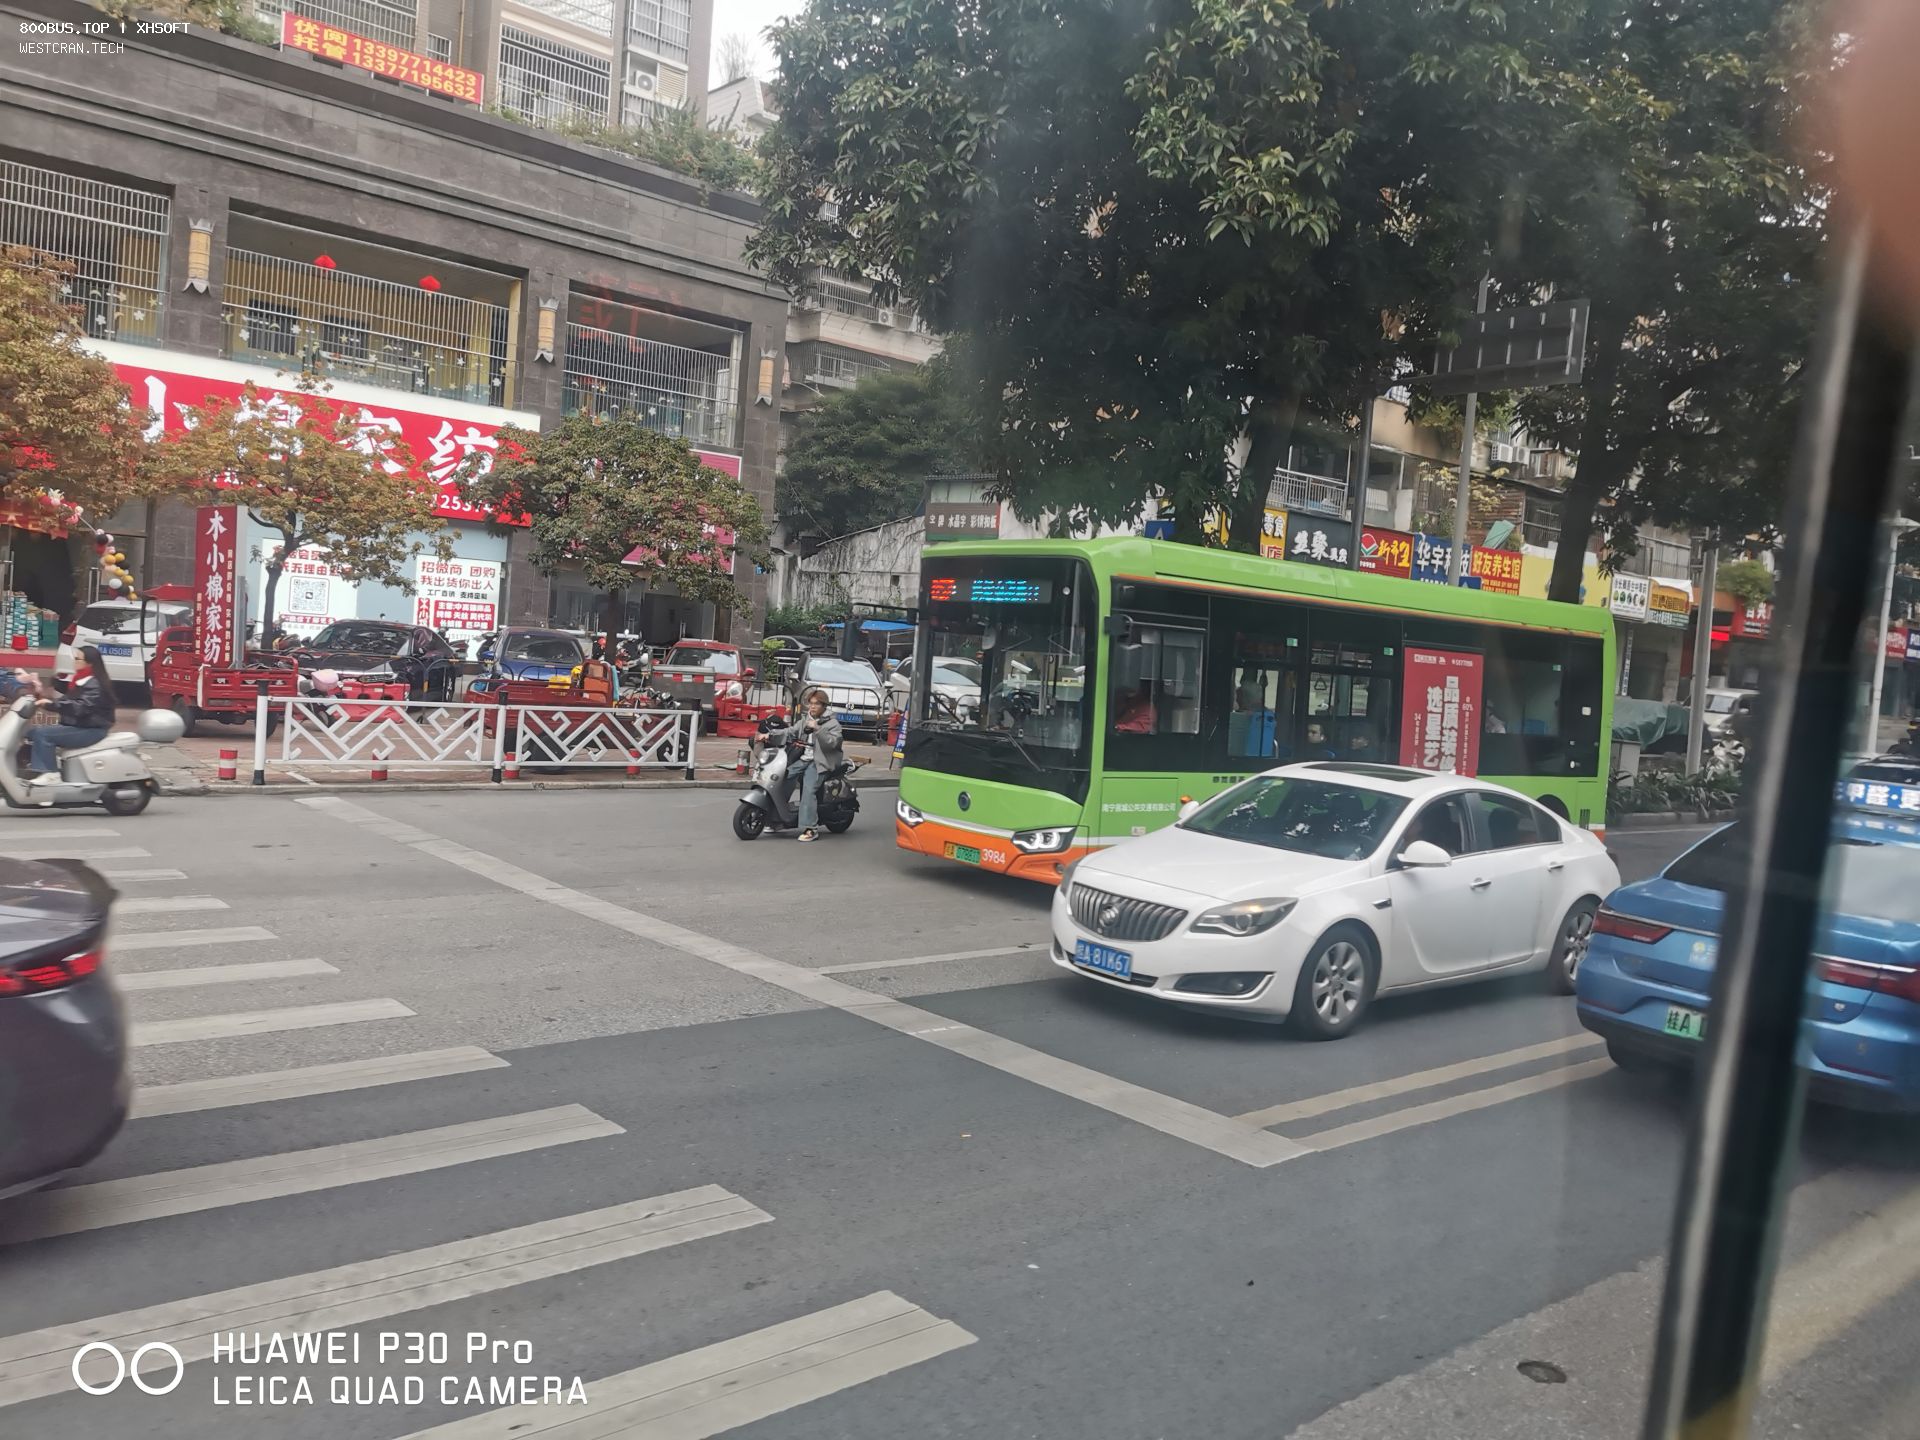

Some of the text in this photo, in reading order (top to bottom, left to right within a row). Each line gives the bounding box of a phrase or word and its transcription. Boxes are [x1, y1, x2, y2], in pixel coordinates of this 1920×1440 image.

[352, 52, 476, 100] 13377195632
[353, 38, 476, 86] 13397714423
[470, 565, 496, 578] 团购
[1472, 550, 1521, 580] 好友养生馆
[204, 509, 228, 664] 木小棉家纺
[420, 575, 494, 591] 我出货你出人
[982, 848, 1006, 864] 3984
[1667, 1011, 1704, 1037] 桂A
